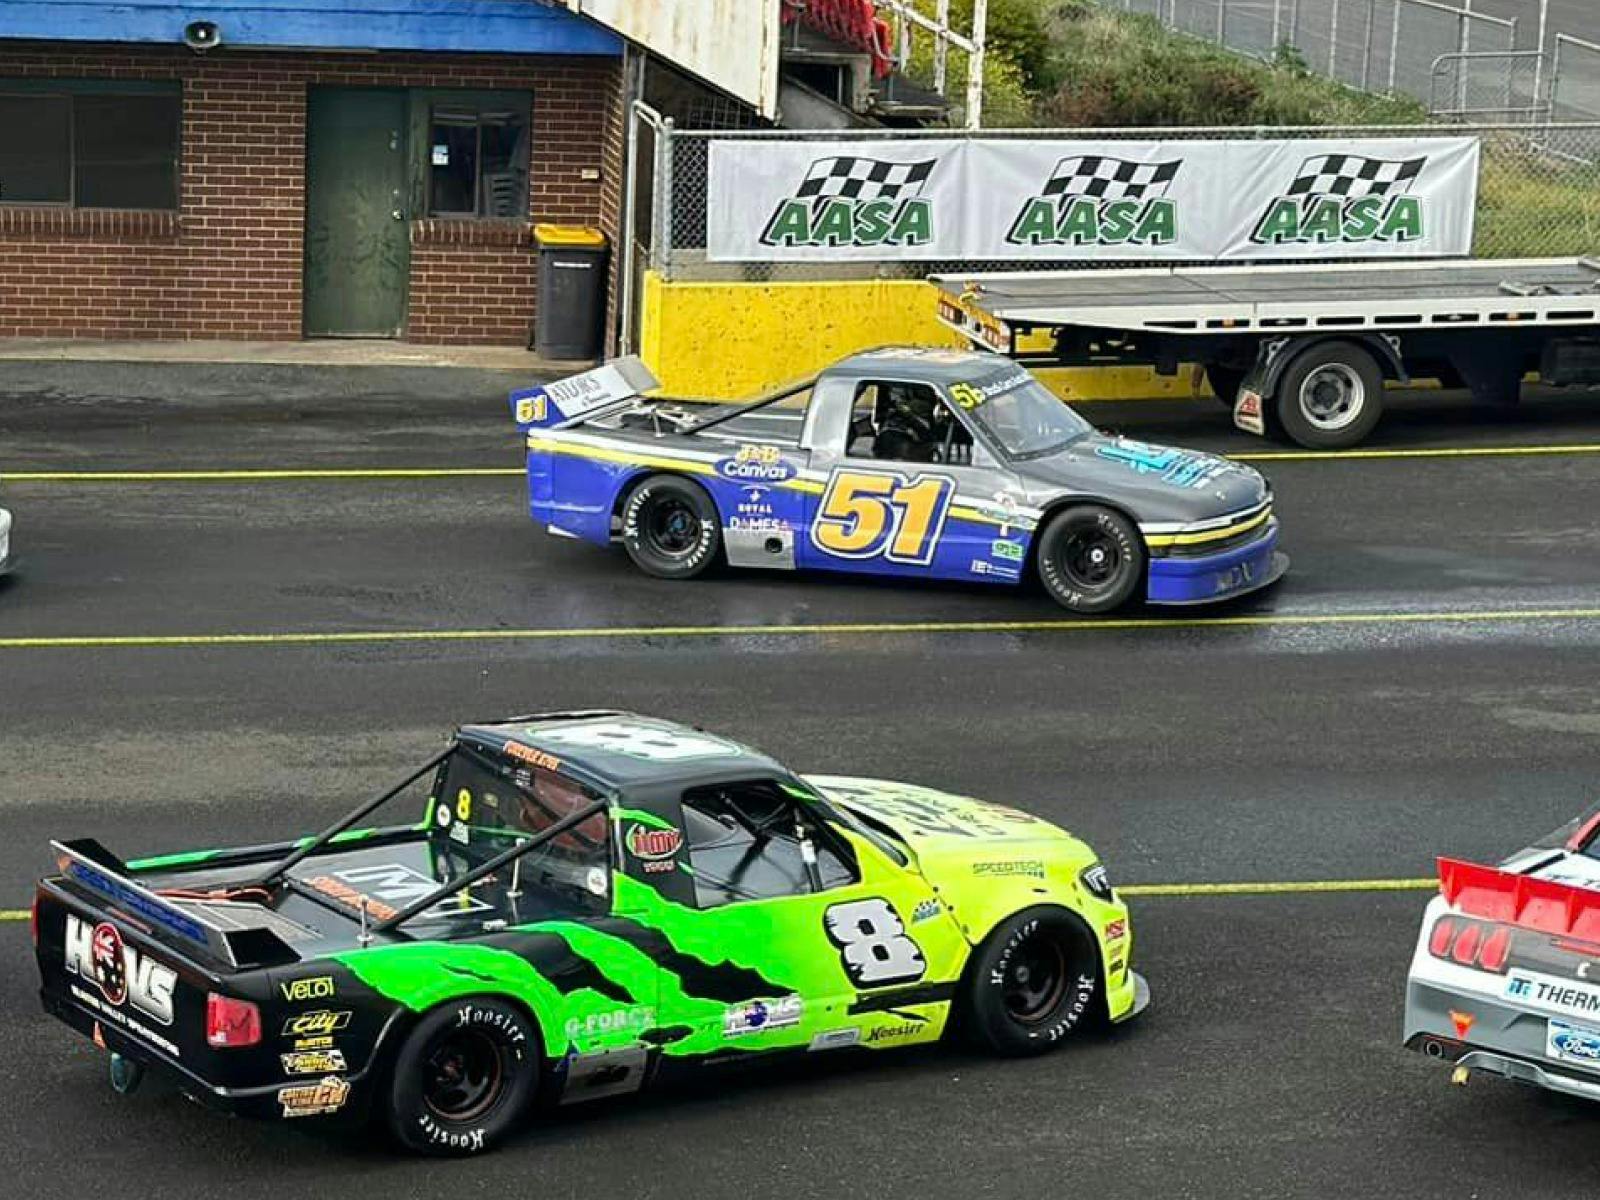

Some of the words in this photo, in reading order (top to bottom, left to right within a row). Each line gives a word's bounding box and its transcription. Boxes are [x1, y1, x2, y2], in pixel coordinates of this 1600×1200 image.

[760, 196, 936, 248] AASA
[1005, 196, 1180, 246] AASA
[1250, 196, 1424, 245] AASA
[516, 395, 548, 423] 51
[724, 461, 788, 480] Canvas
[811, 466, 956, 566] 51
[456, 788, 471, 821] 8
[822, 896, 927, 990] 8
[456, 1005, 525, 1041] Hoosier
[1048, 974, 1095, 1040] Hoosier
[418, 1114, 486, 1151] Hoosier
